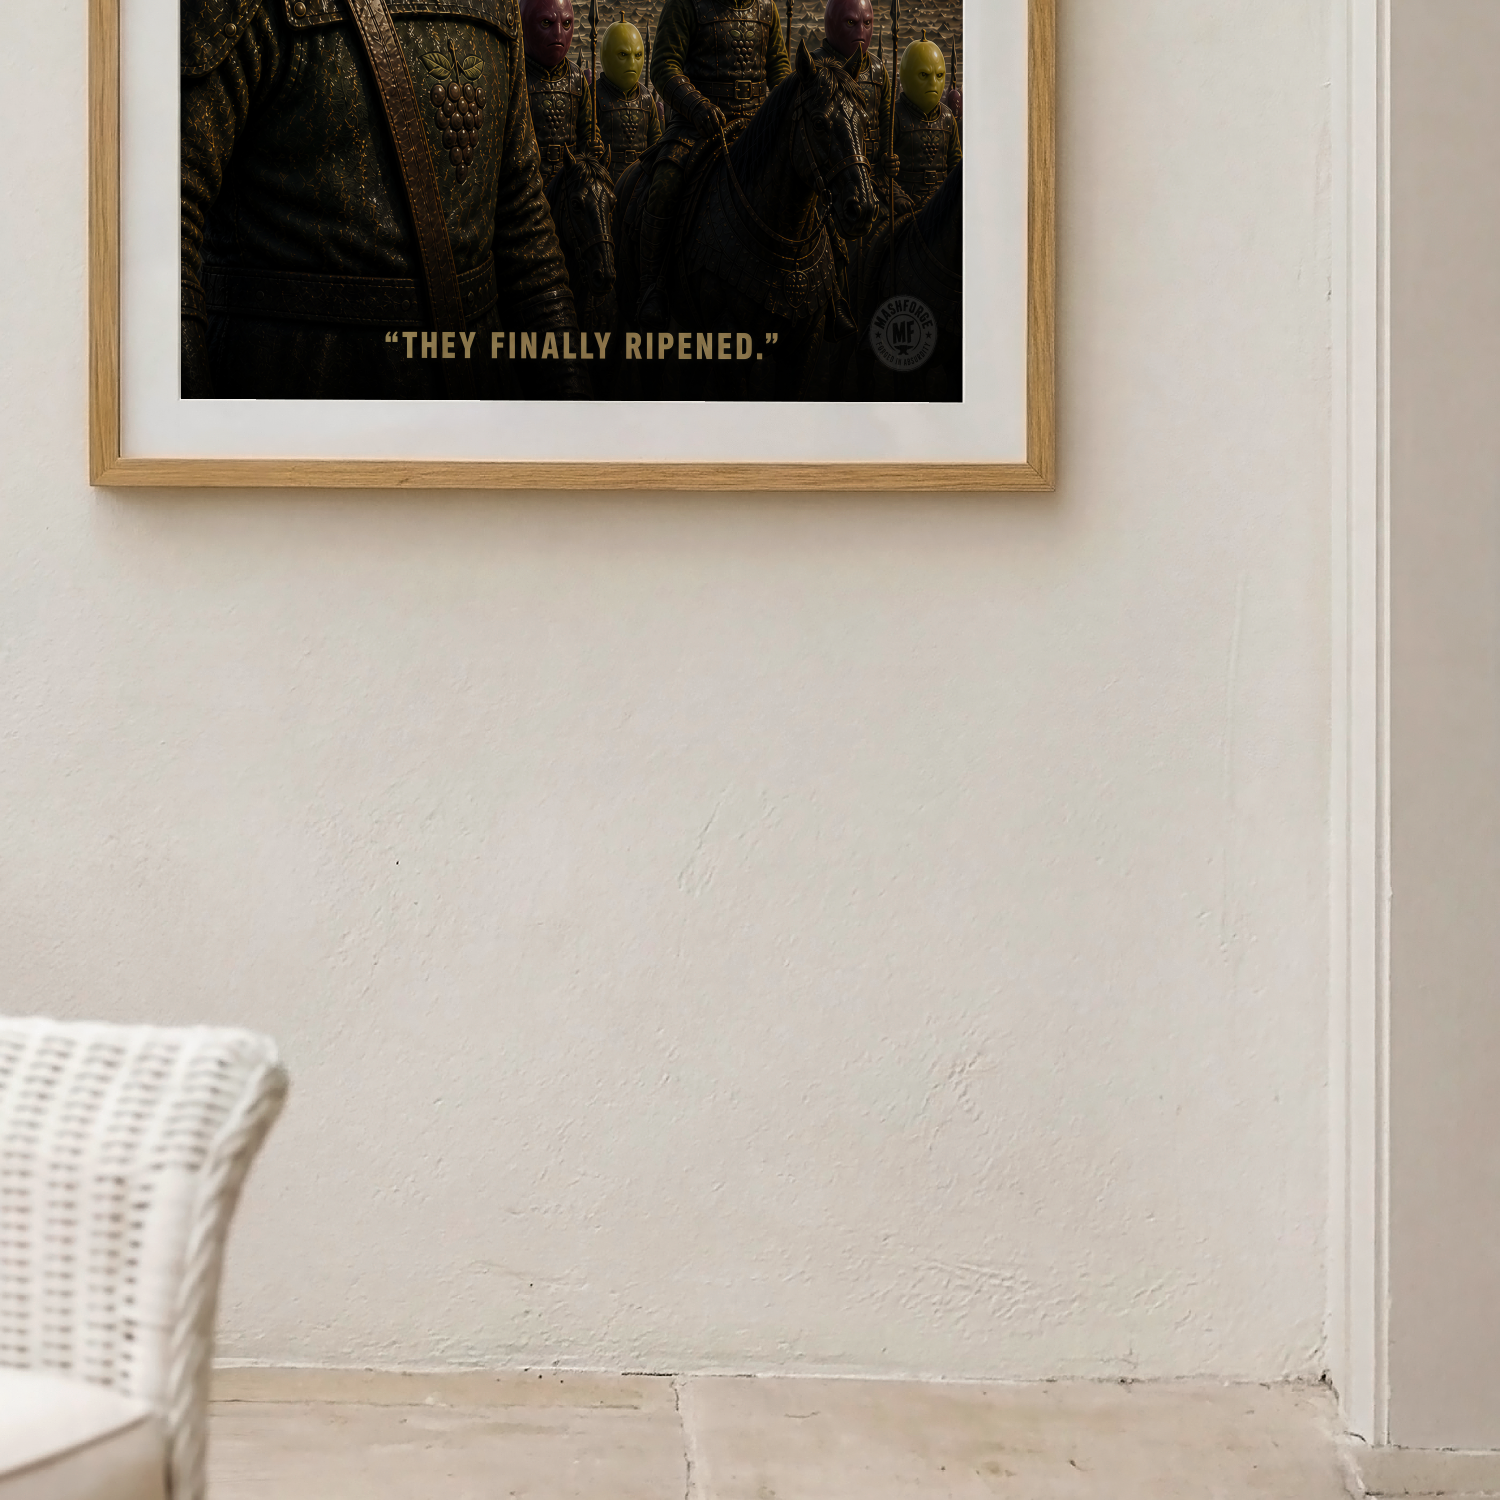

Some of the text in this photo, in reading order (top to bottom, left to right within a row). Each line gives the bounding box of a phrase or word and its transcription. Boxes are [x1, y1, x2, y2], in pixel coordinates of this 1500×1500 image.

[873, 299, 934, 330] MASHFORGE
[384, 330, 779, 360] “THEY FINALLY RIPENED.”
[892, 320, 915, 344] MF
[875, 341, 896, 363] FORGED
[903, 341, 931, 367] ABSURDITY
